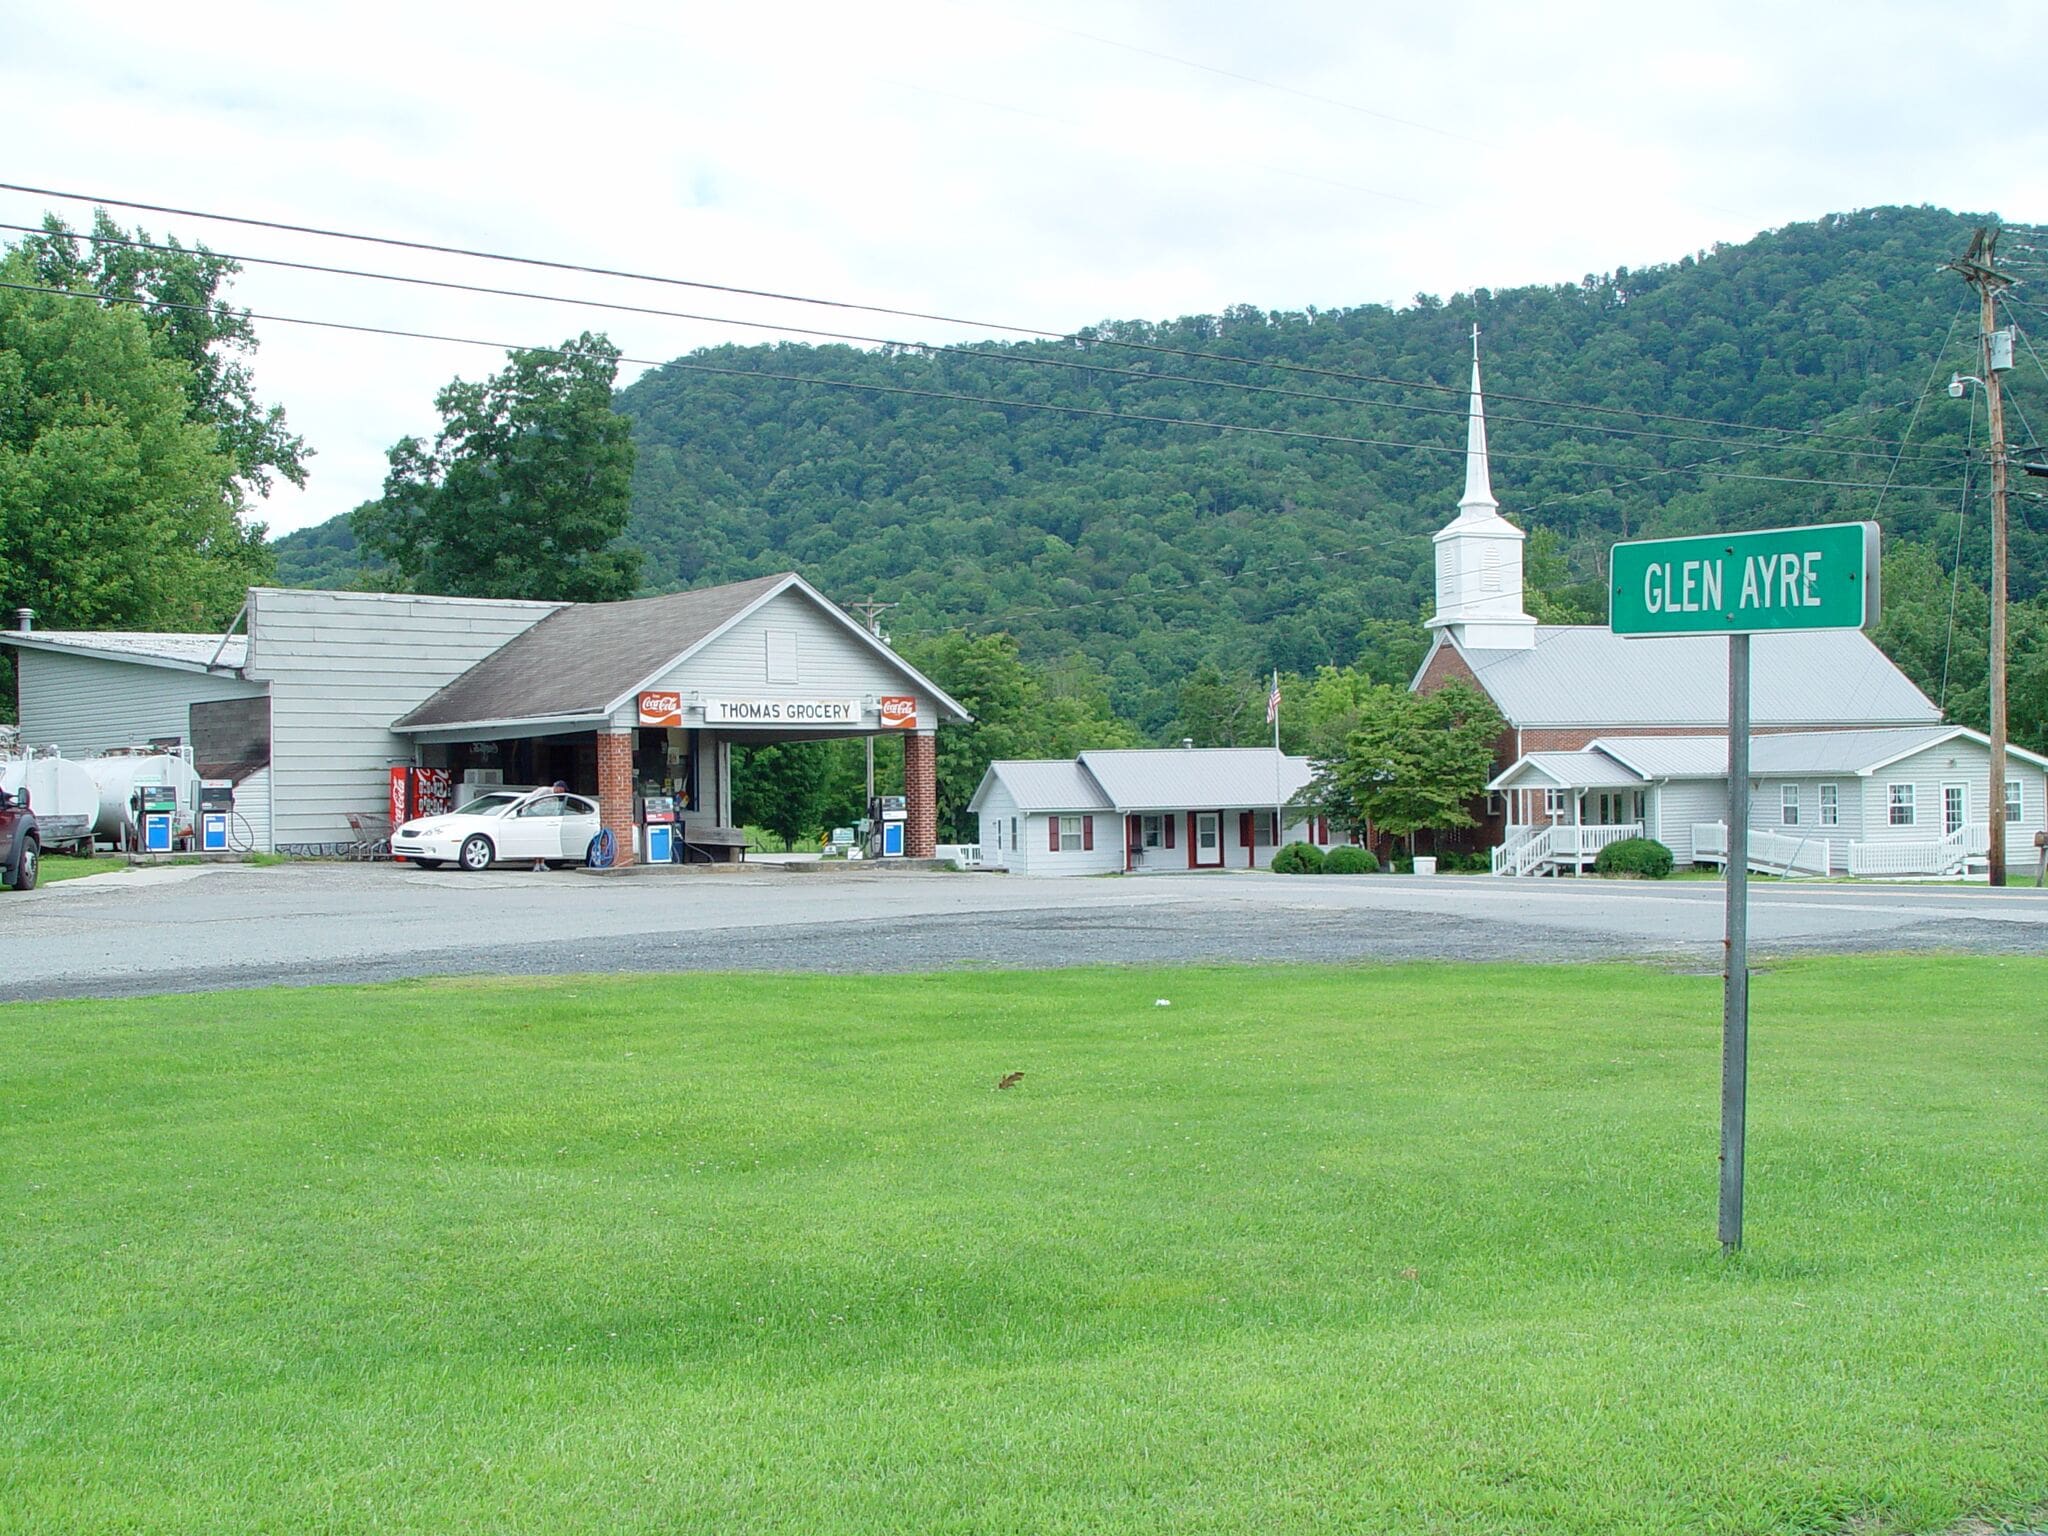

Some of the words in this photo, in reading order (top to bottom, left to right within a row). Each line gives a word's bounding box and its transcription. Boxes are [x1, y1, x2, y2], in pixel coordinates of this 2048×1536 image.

[1644, 559, 1723, 614] GLEN
[1739, 551, 1822, 609] AYRE
[720, 703, 780, 718] THOMAS
[786, 704, 850, 719] GROCERY
